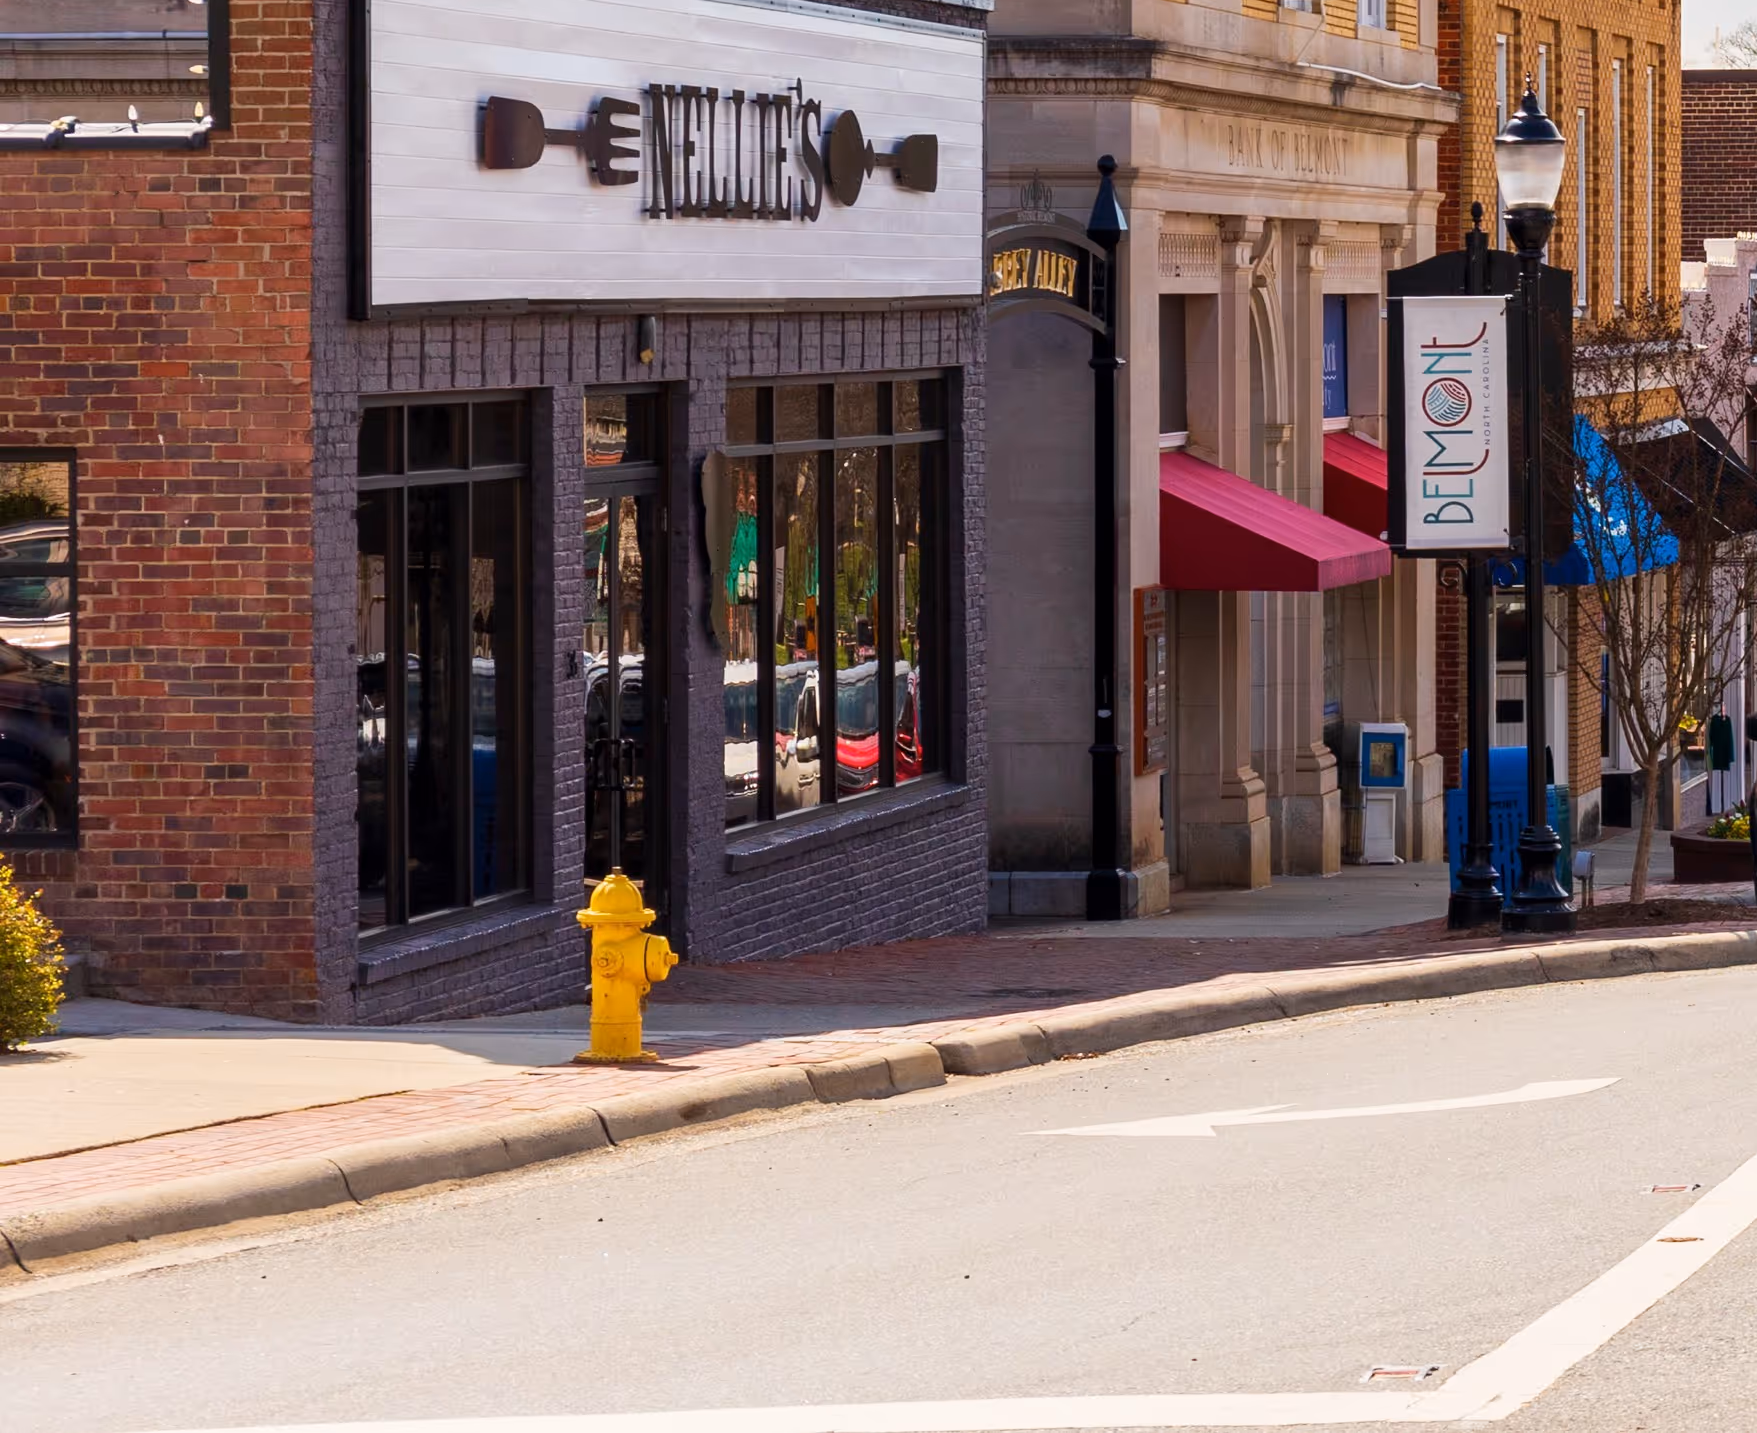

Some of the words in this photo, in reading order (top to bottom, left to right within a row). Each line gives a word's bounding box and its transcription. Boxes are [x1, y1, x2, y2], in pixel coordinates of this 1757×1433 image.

[649, 77, 823, 222] NELLIE'S
[1227, 124, 1264, 168] BANK
[1271, 129, 1286, 171] OF
[1294, 132, 1348, 176] BELMONT
[1033, 249, 1078, 297] ALLEY
[1482, 338, 1490, 399] CAROLINA
